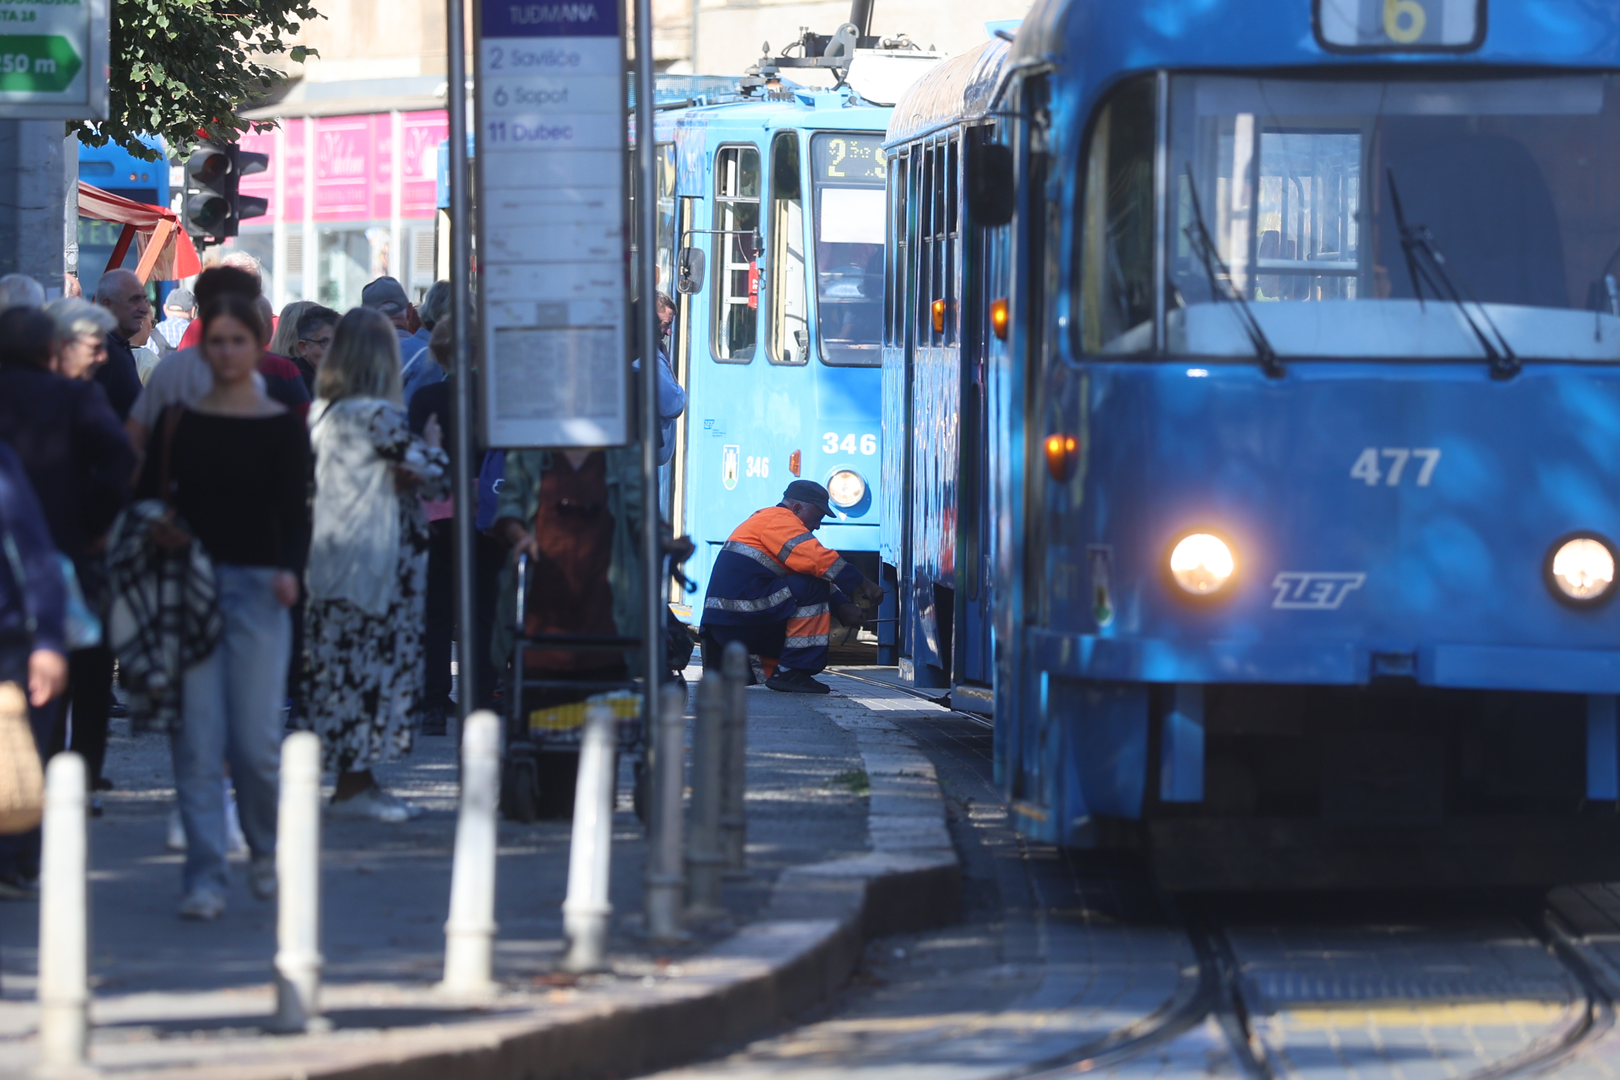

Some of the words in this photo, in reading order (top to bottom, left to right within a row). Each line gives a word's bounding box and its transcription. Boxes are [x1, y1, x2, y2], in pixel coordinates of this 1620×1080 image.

[0, 53, 29, 73] 50
[34, 58, 57, 73] m
[488, 46, 504, 69] 2
[492, 86, 509, 107] 6
[488, 121, 506, 142] 11
[512, 124, 573, 142] Dubec
[828, 138, 846, 177] 2
[822, 432, 877, 456] 346
[746, 456, 770, 478] 346
[1350, 447, 1441, 487] 477
[1271, 571, 1367, 609] ZET
